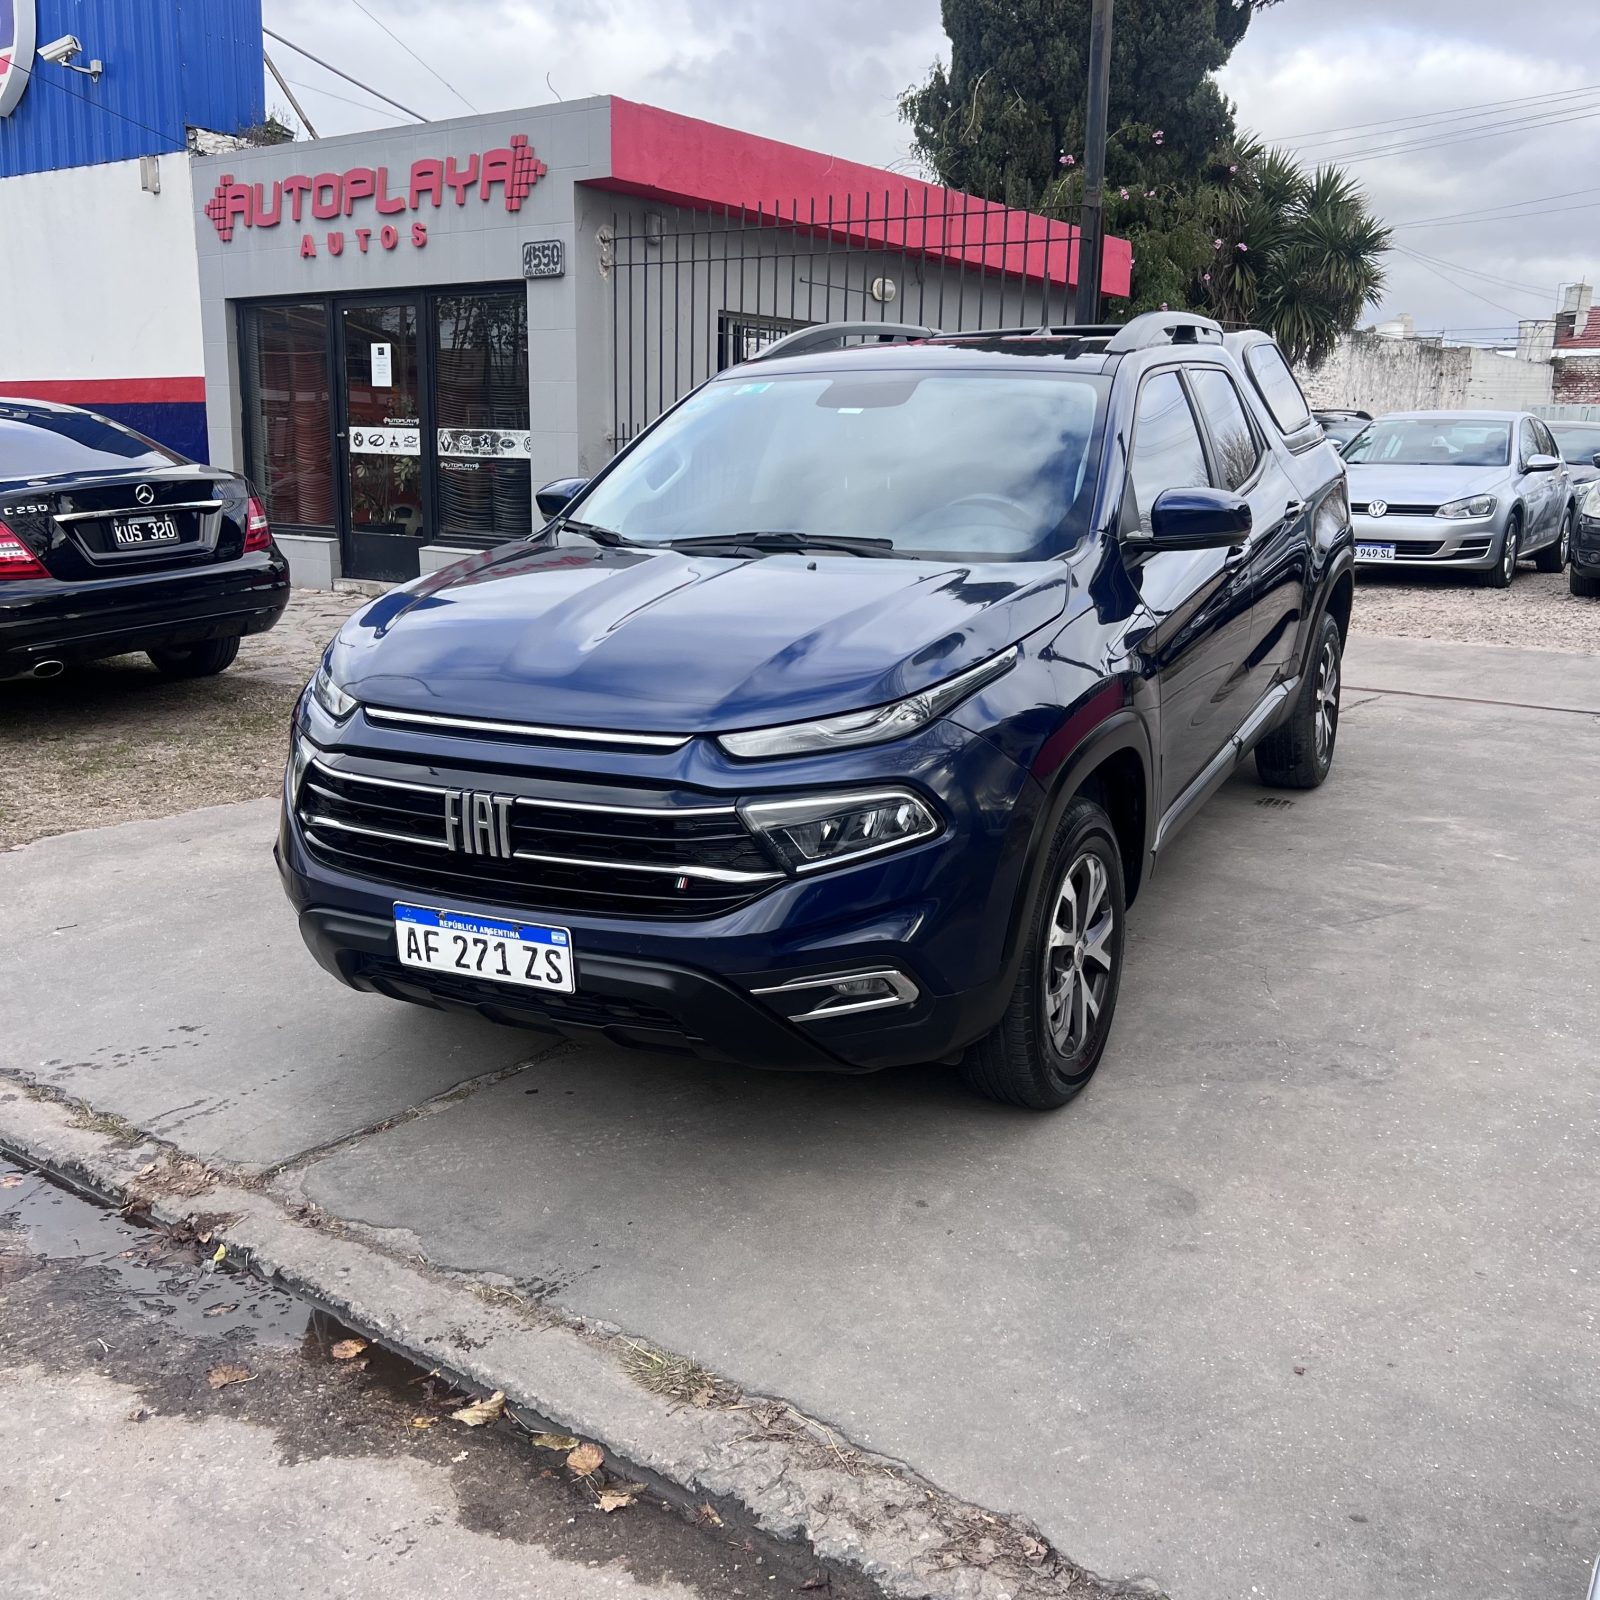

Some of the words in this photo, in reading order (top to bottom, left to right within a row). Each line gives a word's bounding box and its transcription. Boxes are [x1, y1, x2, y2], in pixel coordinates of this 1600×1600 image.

[225, 147, 516, 228] AUTOPLAYA
[300, 222, 428, 258] AUTOS
[524, 242, 560, 268] 4550
[3, 507, 14, 516] C
[16, 504, 49, 515] 250
[114, 524, 143, 543] KUS
[148, 521, 175, 540] 320
[1360, 548, 1378, 558] 949
[1380, 549, 1392, 559] SL
[444, 789, 515, 859] FIAT
[439, 919, 478, 933] REPÚBLICA
[479, 925, 521, 940] ARGENTINA
[406, 927, 440, 963] AF
[452, 934, 512, 977] 271
[522, 945, 563, 984] ZS
